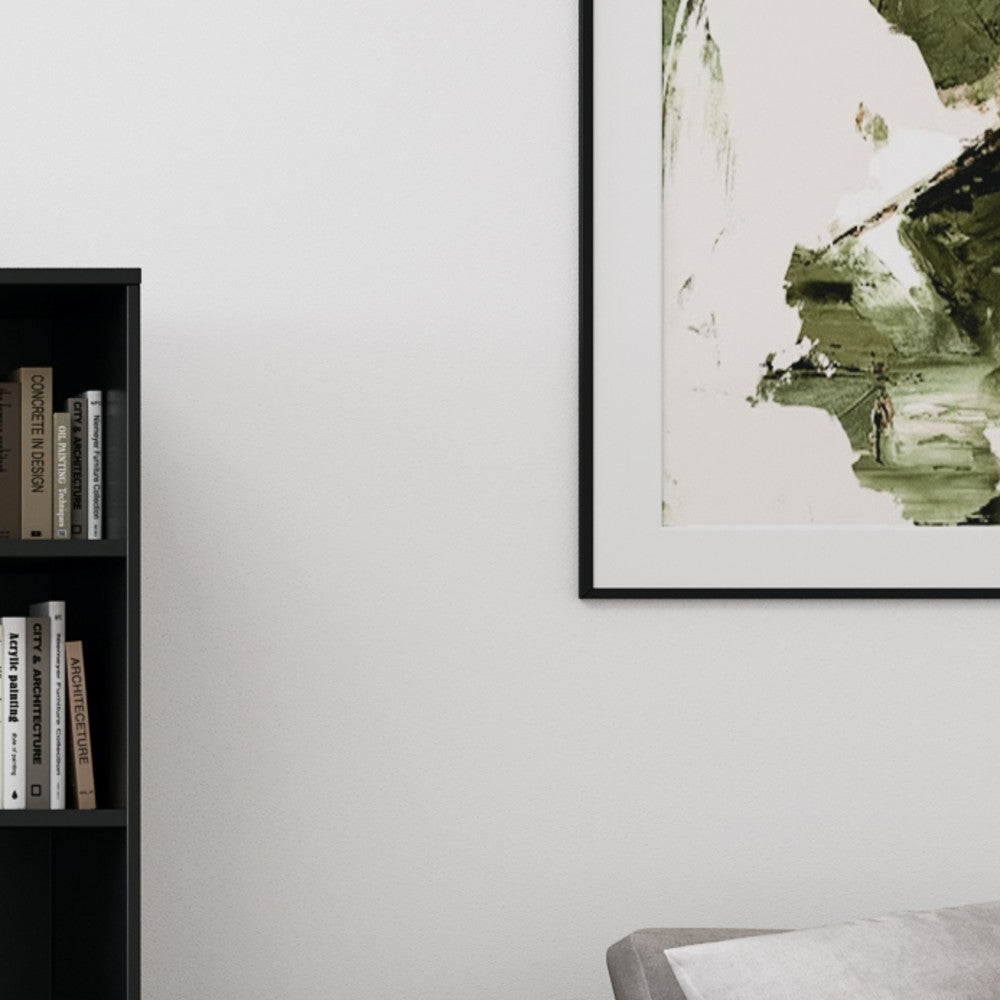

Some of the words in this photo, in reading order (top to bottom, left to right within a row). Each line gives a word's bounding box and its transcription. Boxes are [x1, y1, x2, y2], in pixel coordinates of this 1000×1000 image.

[31, 374, 44, 435] CONCRETE
[74, 401, 82, 423] CITY
[31, 438, 44, 449] IN
[57, 425, 67, 441] OIL
[92, 415, 100, 448] Niemeyer
[31, 451, 44, 493] DESIGN
[57, 442, 67, 484] PAINTING
[74, 438, 82, 510] ARCHITECTURE
[8, 632, 19, 671] Acrylic
[33, 622, 42, 652] CITY
[33, 654, 42, 664] &
[8, 674, 19, 722] painting
[33, 668, 42, 764] ARCHITECTURE
[70, 657, 89, 765] ARCHITECETURE
